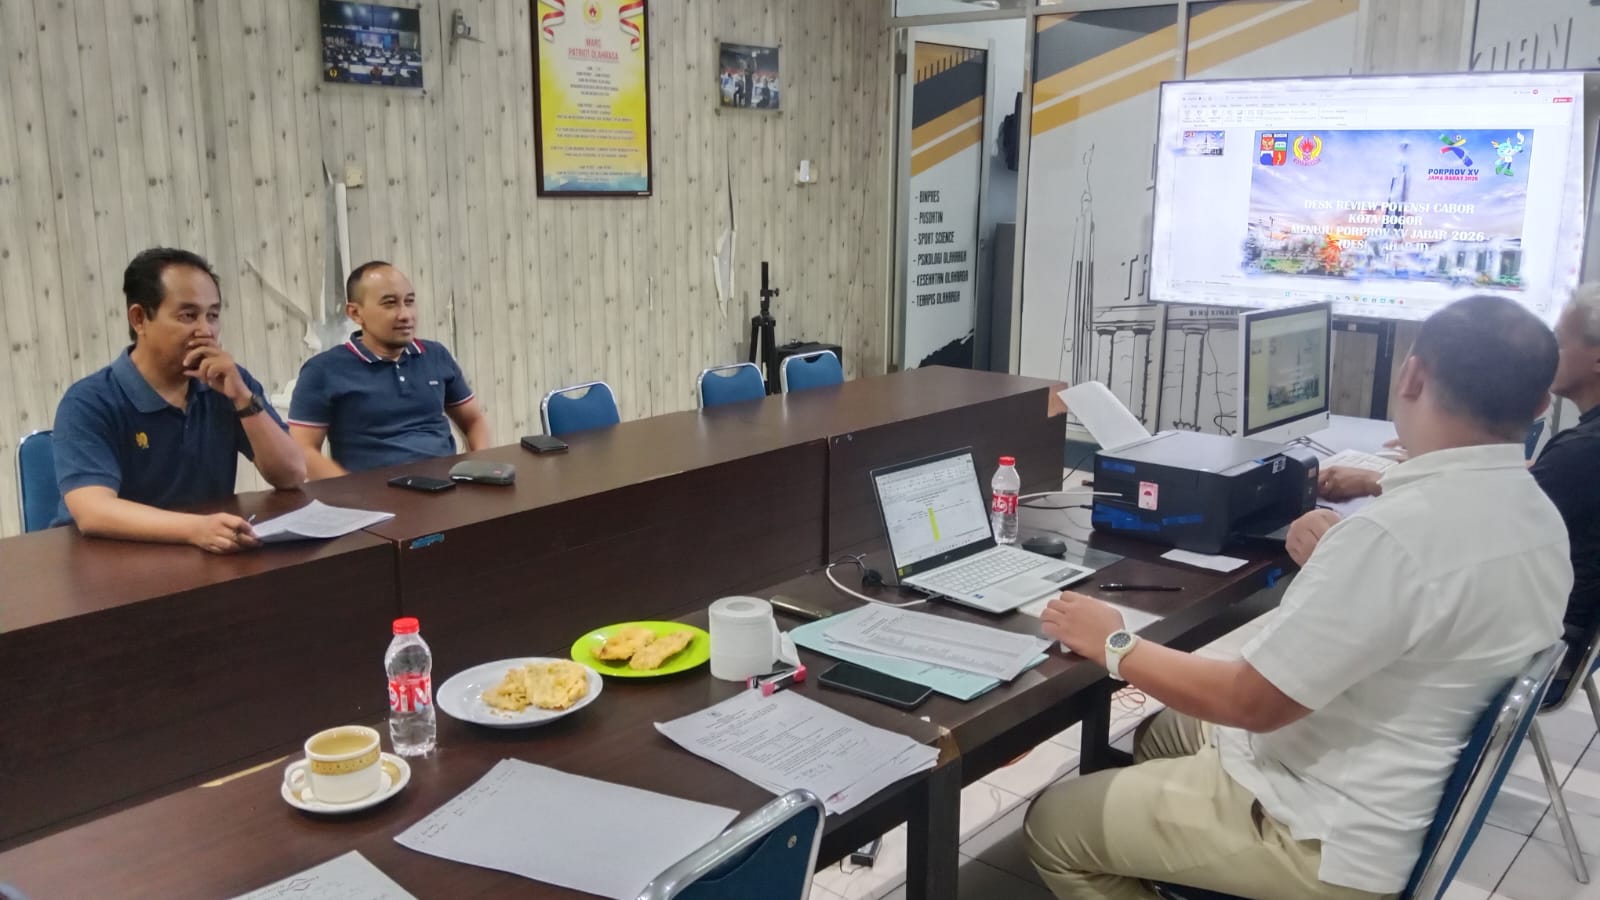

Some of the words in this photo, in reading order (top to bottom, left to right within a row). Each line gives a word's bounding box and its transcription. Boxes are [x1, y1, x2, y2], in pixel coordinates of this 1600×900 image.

[1304, 200, 1332, 209] DESK
[1336, 200, 1376, 211] REVIEW
[1381, 201, 1430, 213] POTENSI
[1433, 203, 1475, 214] CABOR
[1348, 214, 1378, 224] KOTA
[1382, 215, 1423, 226] BOGOR
[918, 232, 934, 245] SPORT
[935, 231, 955, 244] SCIENCE
[1291, 225, 1333, 235] MENUJU
[1336, 226, 1390, 237] PORPROV
[1410, 230, 1447, 240] JABAR
[1451, 231, 1485, 242] 2026
[917, 252, 942, 266] PSIKOLOGI
[916, 272, 944, 287] KESEHATAN
